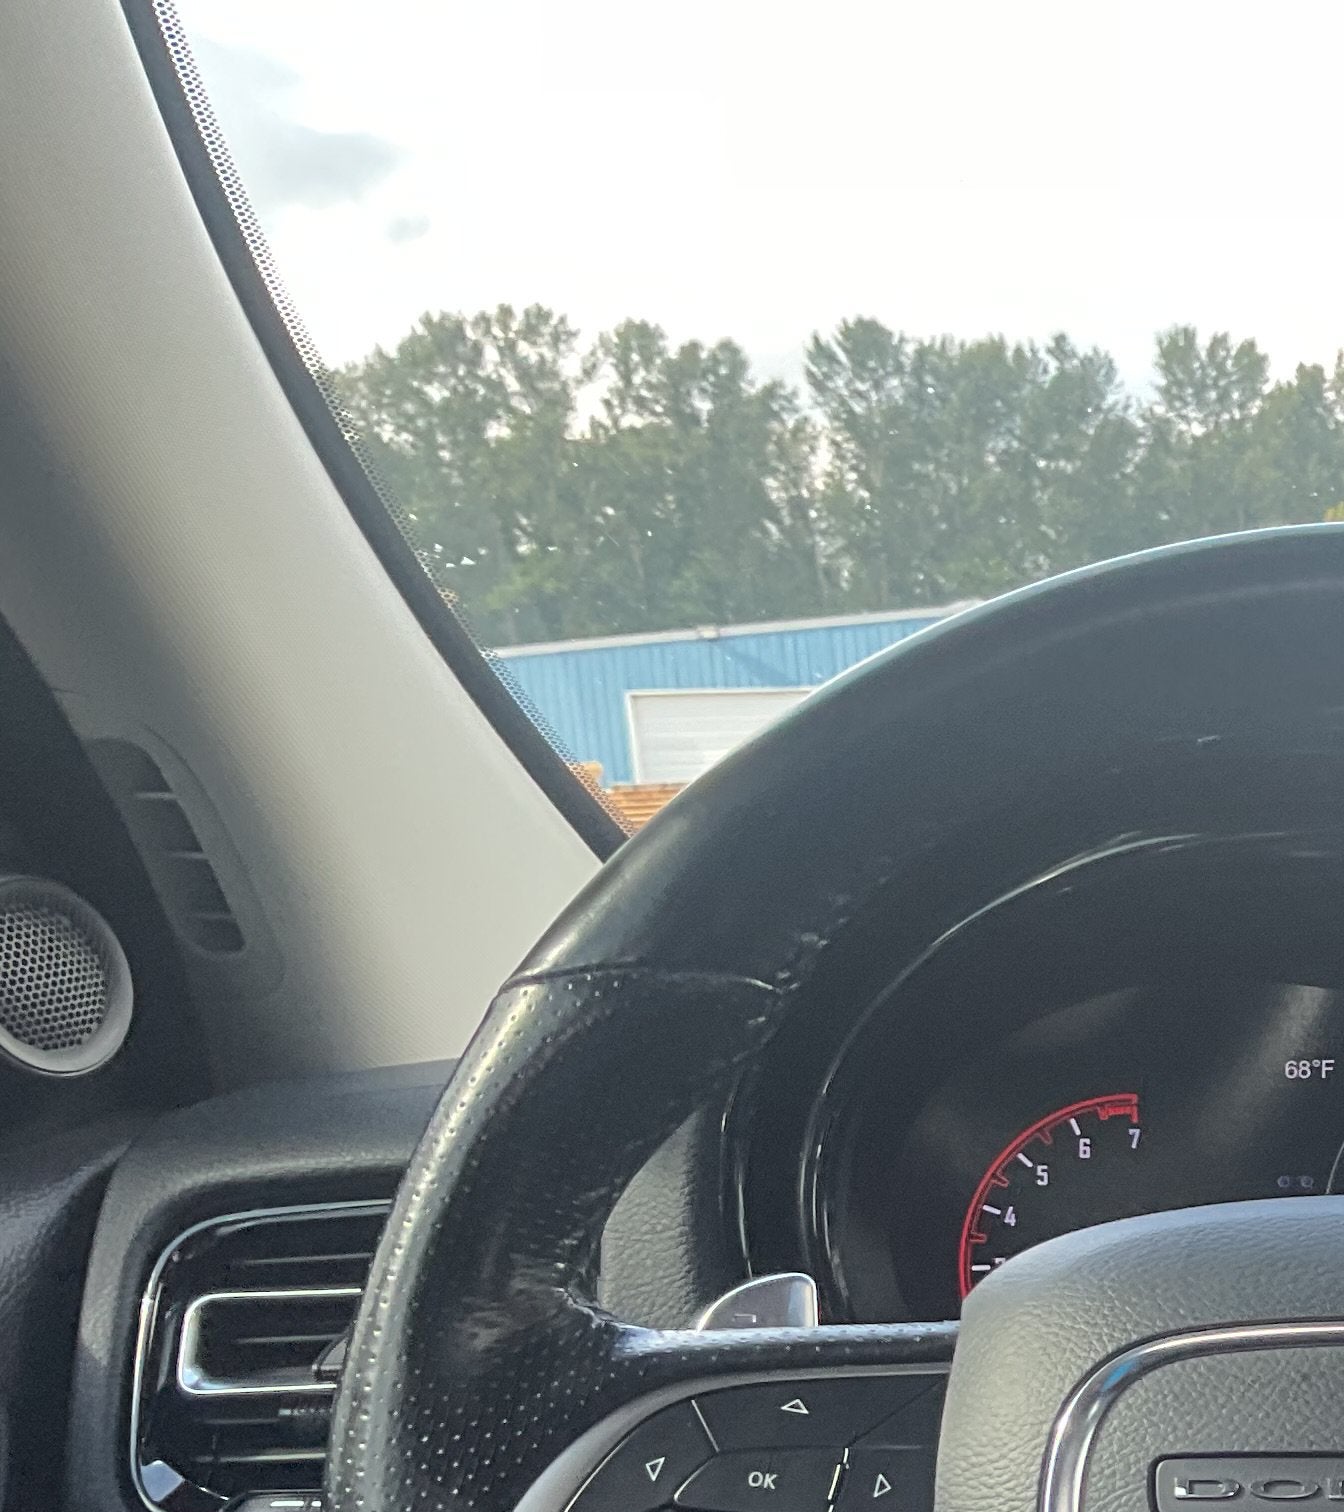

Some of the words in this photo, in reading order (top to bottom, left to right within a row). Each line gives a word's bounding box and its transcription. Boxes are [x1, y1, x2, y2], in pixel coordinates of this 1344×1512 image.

[1283, 1059, 1335, 1080] 68°F
[1078, 1137, 1092, 1160] 6
[1128, 1128, 1142, 1149] 7
[1035, 1164, 1049, 1187] 5
[1003, 1206, 1017, 1227] 4
[748, 1470, 778, 1490] OK
